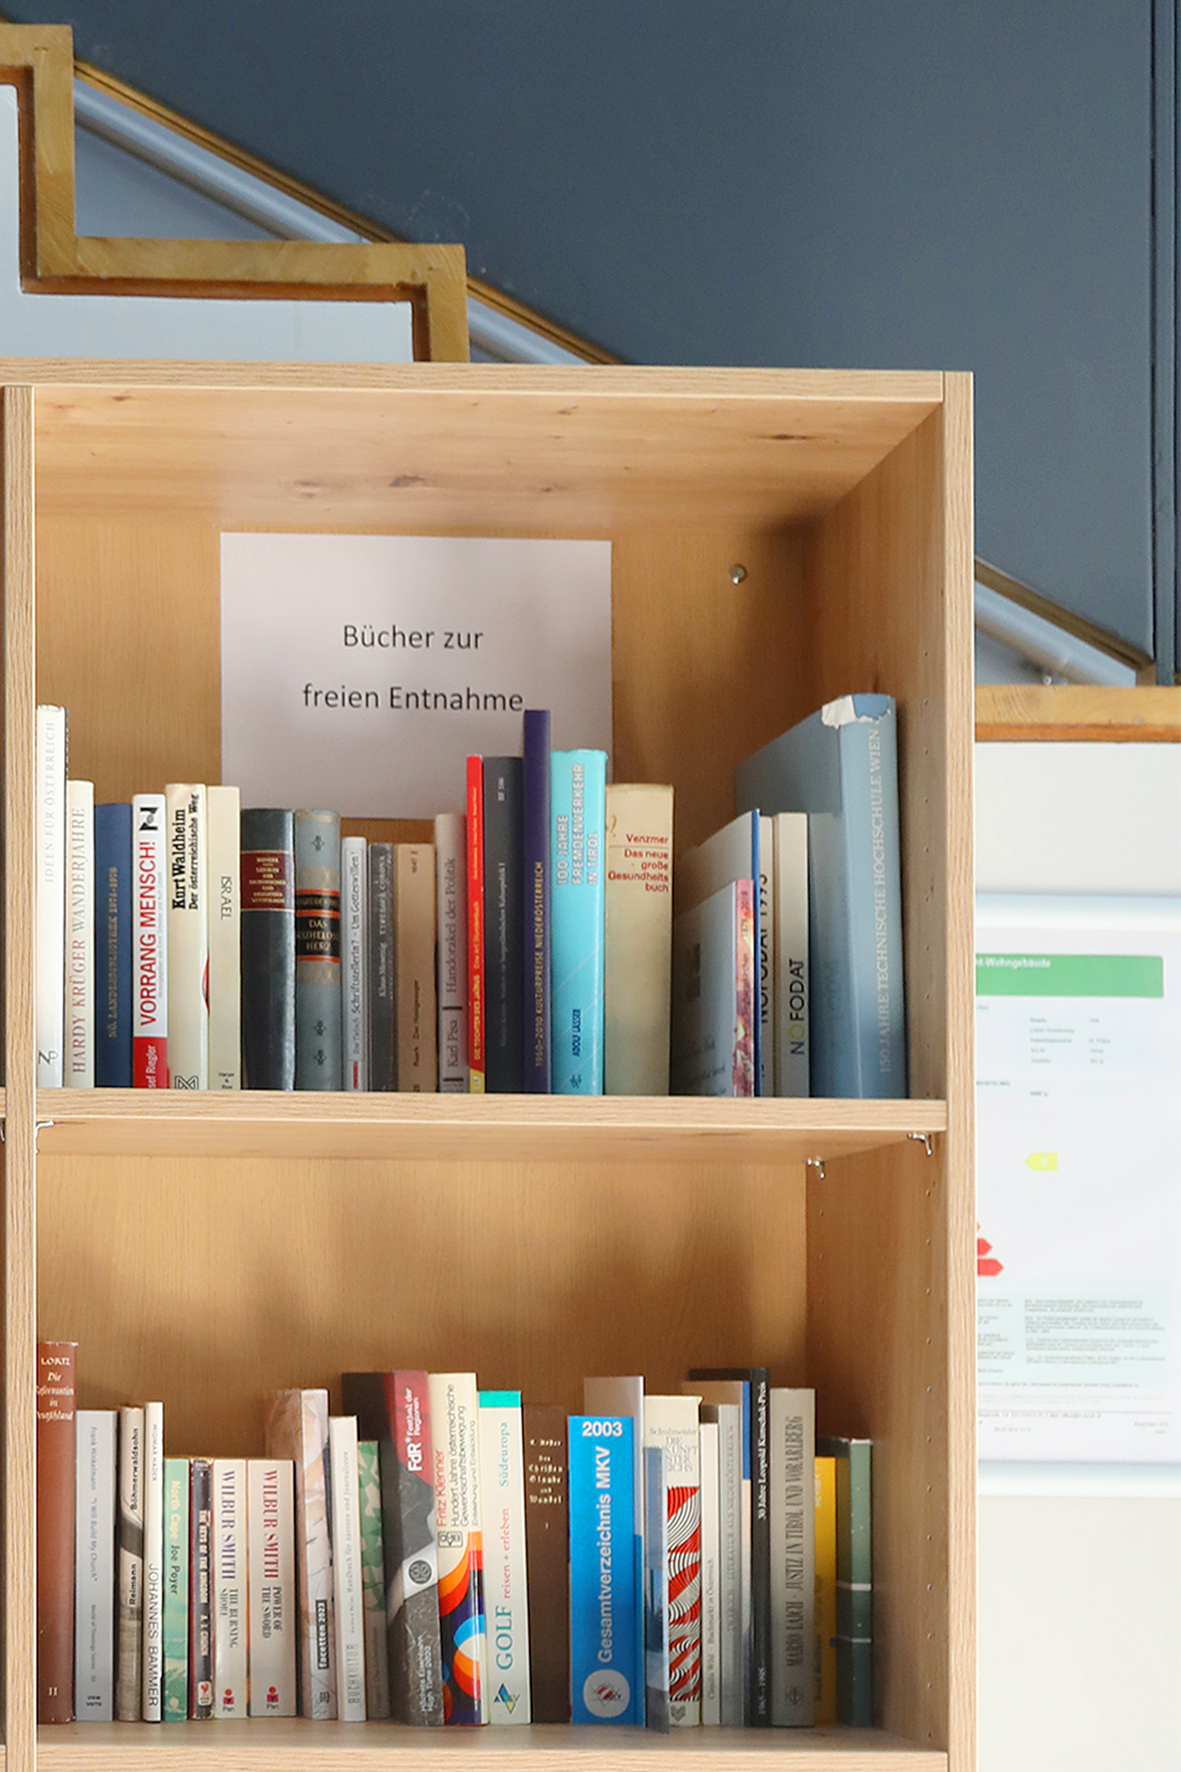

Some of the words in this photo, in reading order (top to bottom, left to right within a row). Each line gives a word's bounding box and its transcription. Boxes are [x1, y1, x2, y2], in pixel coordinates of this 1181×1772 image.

[343, 625, 434, 648] Bücher
[443, 630, 484, 649] zur
[303, 683, 379, 708] freien
[390, 686, 523, 711] Entnahme
[869, 727, 882, 771] WIEN
[189, 794, 199, 814] Weg
[172, 810, 186, 871] Waldheim
[557, 816, 568, 857] JAHRE
[626, 835, 668, 844] Venzmer
[871, 775, 886, 885] HOCHSCHULE
[73, 808, 86, 932] WANDERJAHRE
[189, 817, 198, 888] österreichische
[557, 862, 567, 885] 100
[624, 849, 643, 858] Das
[645, 851, 668, 859] neue
[641, 862, 668, 871] große
[139, 842, 156, 927] MENSCH!
[173, 874, 186, 910] Kurt
[221, 876, 232, 920] ISRAEL
[608, 872, 668, 882] Gesundheits
[645, 883, 668, 892] buch
[189, 892, 198, 910] Der
[873, 891, 889, 991] TECHNISCHE
[70, 939, 86, 1008] KRÜGER
[140, 932, 156, 1026] VORRANG
[877, 994, 891, 1040] JAHRE
[73, 1014, 86, 1073] HARDY
[879, 1042, 891, 1074] 150
[582, 1421, 623, 1437] 2003
[435, 1450, 446, 1496] Klenner
[500, 1422, 509, 1486] Südeuropa
[596, 1446, 611, 1489] MKV
[221, 1470, 235, 1529] WILBUR
[263, 1469, 279, 1529] WILBUR
[437, 1500, 447, 1526] Fritz
[501, 1508, 510, 1547] erleben
[169, 1544, 178, 1564] Joe
[221, 1533, 236, 1579] SMITH
[264, 1532, 279, 1578] SMITH
[169, 1566, 178, 1595] Poyer
[502, 1558, 511, 1598] reisen
[597, 1494, 613, 1663] Gesamtverzeichnis
[148, 1563, 158, 1639] JOHANNES
[495, 1605, 513, 1669] GOLF
[148, 1647, 158, 1707] BAMMER
